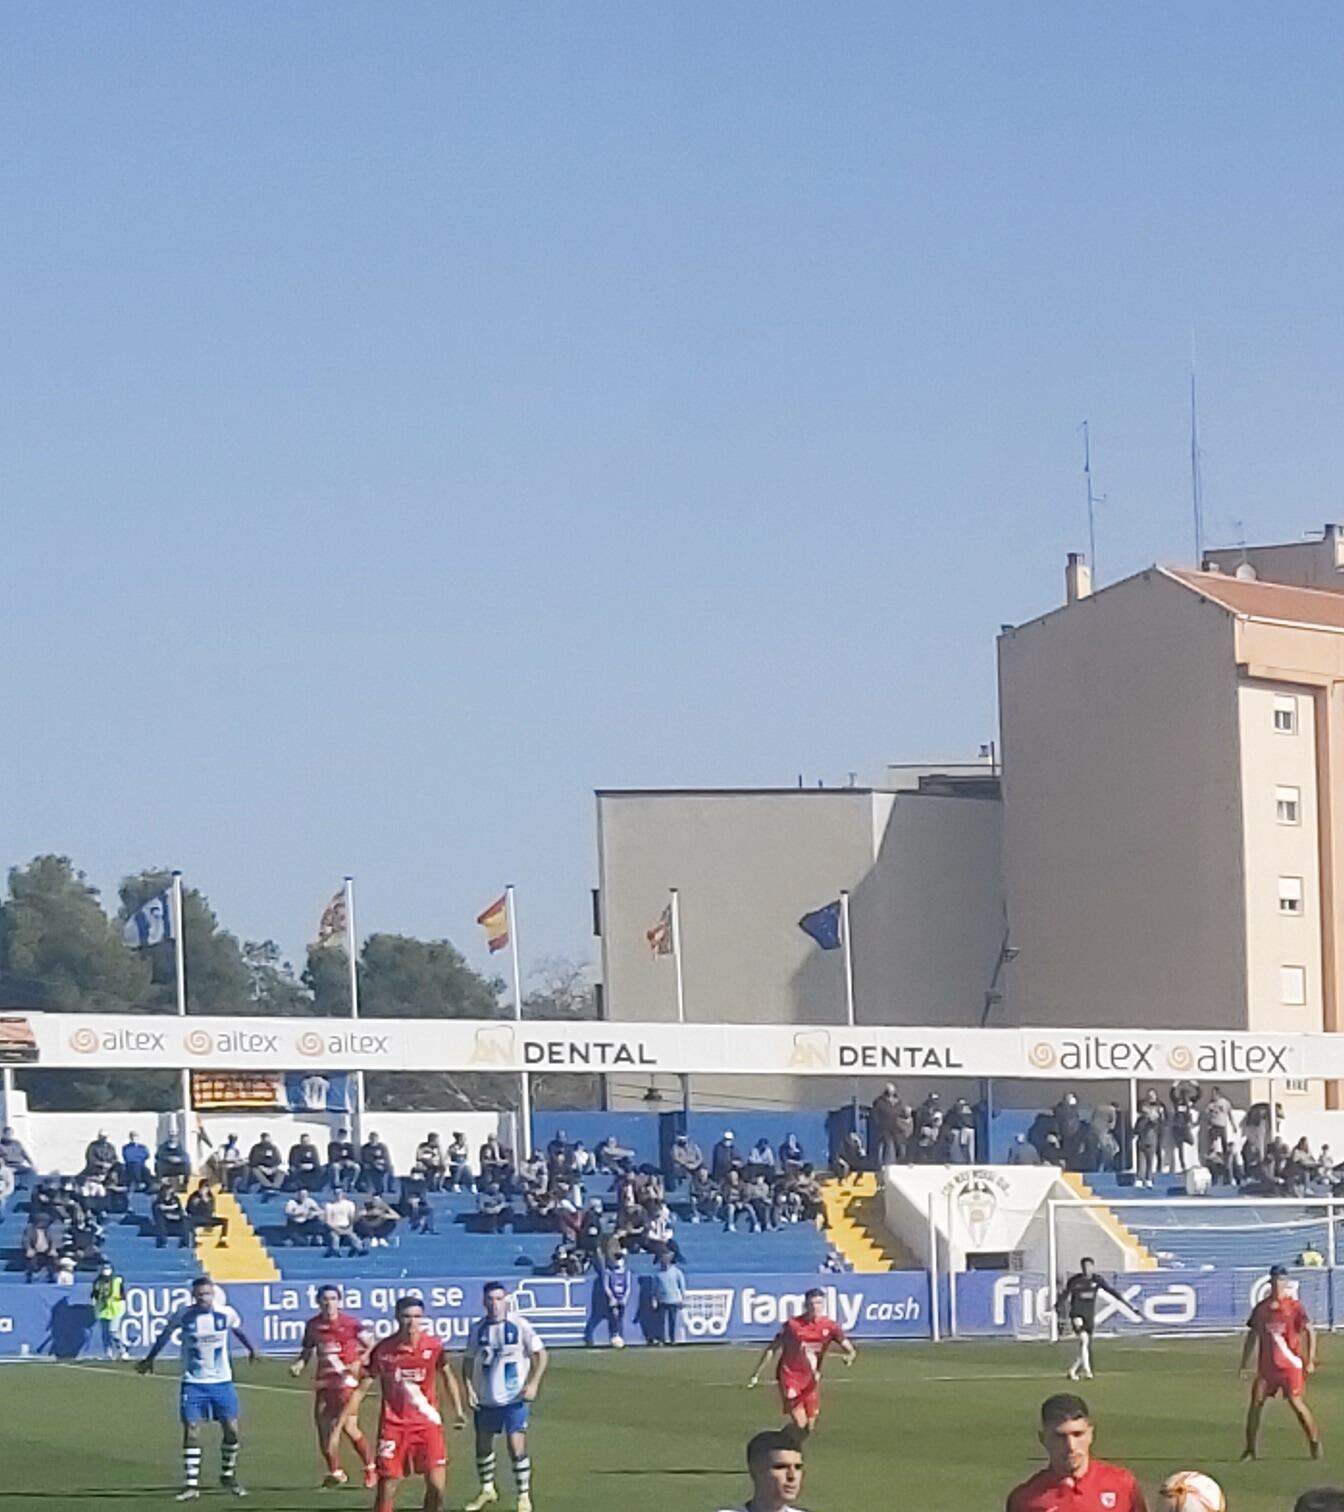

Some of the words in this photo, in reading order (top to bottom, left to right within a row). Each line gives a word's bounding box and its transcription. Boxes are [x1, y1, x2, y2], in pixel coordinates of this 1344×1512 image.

[102, 1028, 165, 1052] aitex
[217, 1030, 279, 1054] aitex
[328, 1032, 388, 1054] aitex
[523, 1041, 658, 1065] DENTAL
[839, 1045, 963, 1069] DENTAL
[1059, 1036, 1154, 1071] aitex
[1198, 1039, 1288, 1073] aitex
[262, 1285, 298, 1310] La
[305, 1284, 362, 1309] tla
[431, 1286, 463, 1308] se
[865, 1297, 920, 1321] cash
